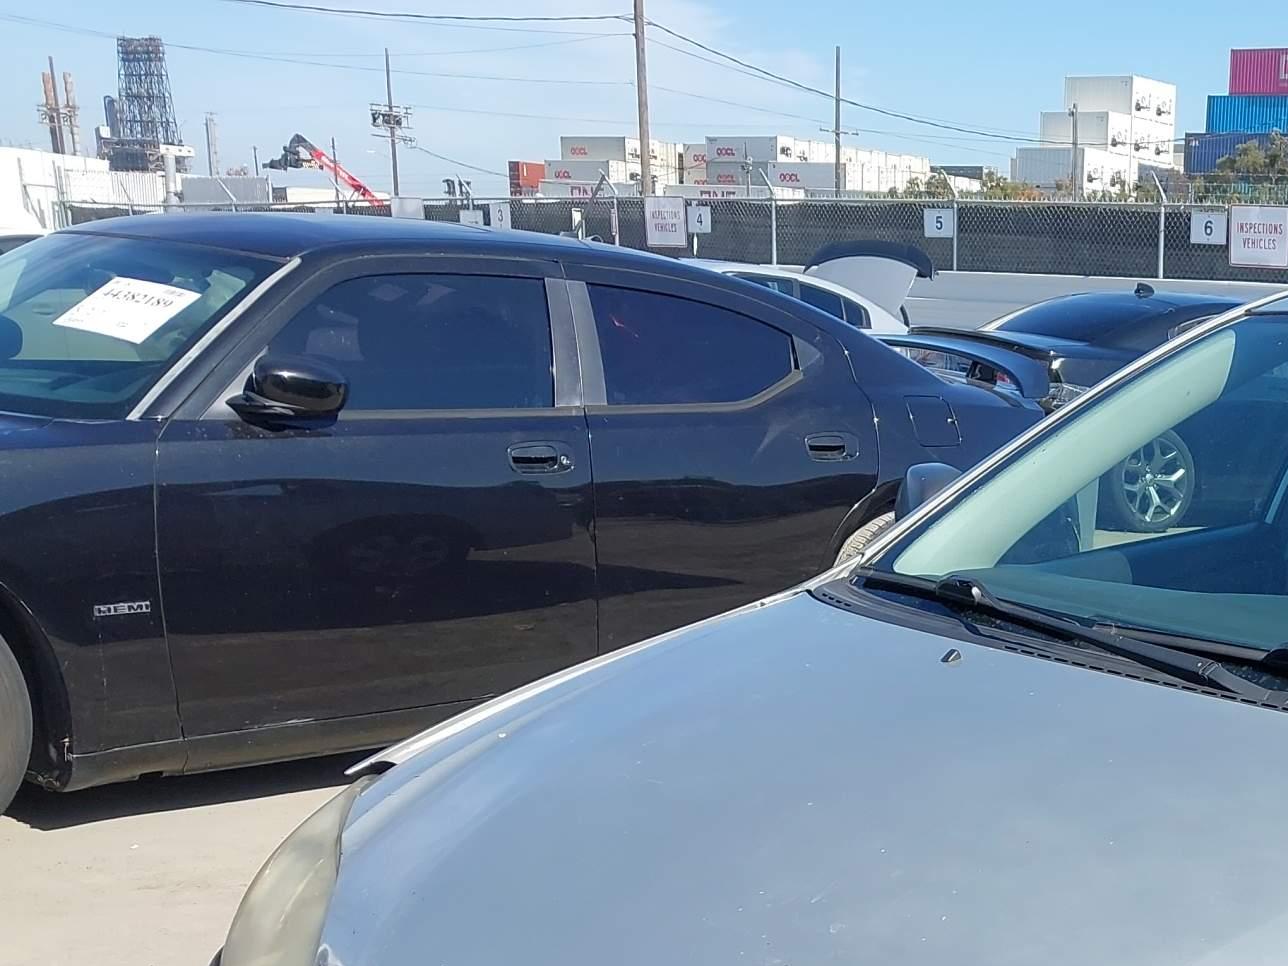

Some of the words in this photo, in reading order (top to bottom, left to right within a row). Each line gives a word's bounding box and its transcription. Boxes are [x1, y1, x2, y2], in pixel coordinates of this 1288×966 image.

[716, 147, 736, 157] OOCL
[779, 173, 800, 182] OOCL
[497, 208, 504, 223] 3
[696, 213, 703, 227] 4
[935, 215, 944, 231] 5
[1204, 220, 1214, 237] 6
[1236, 222, 1283, 236] INSPECTIONS
[1243, 237, 1277, 250] VEHICLES
[94, 601, 151, 616] HEMI
